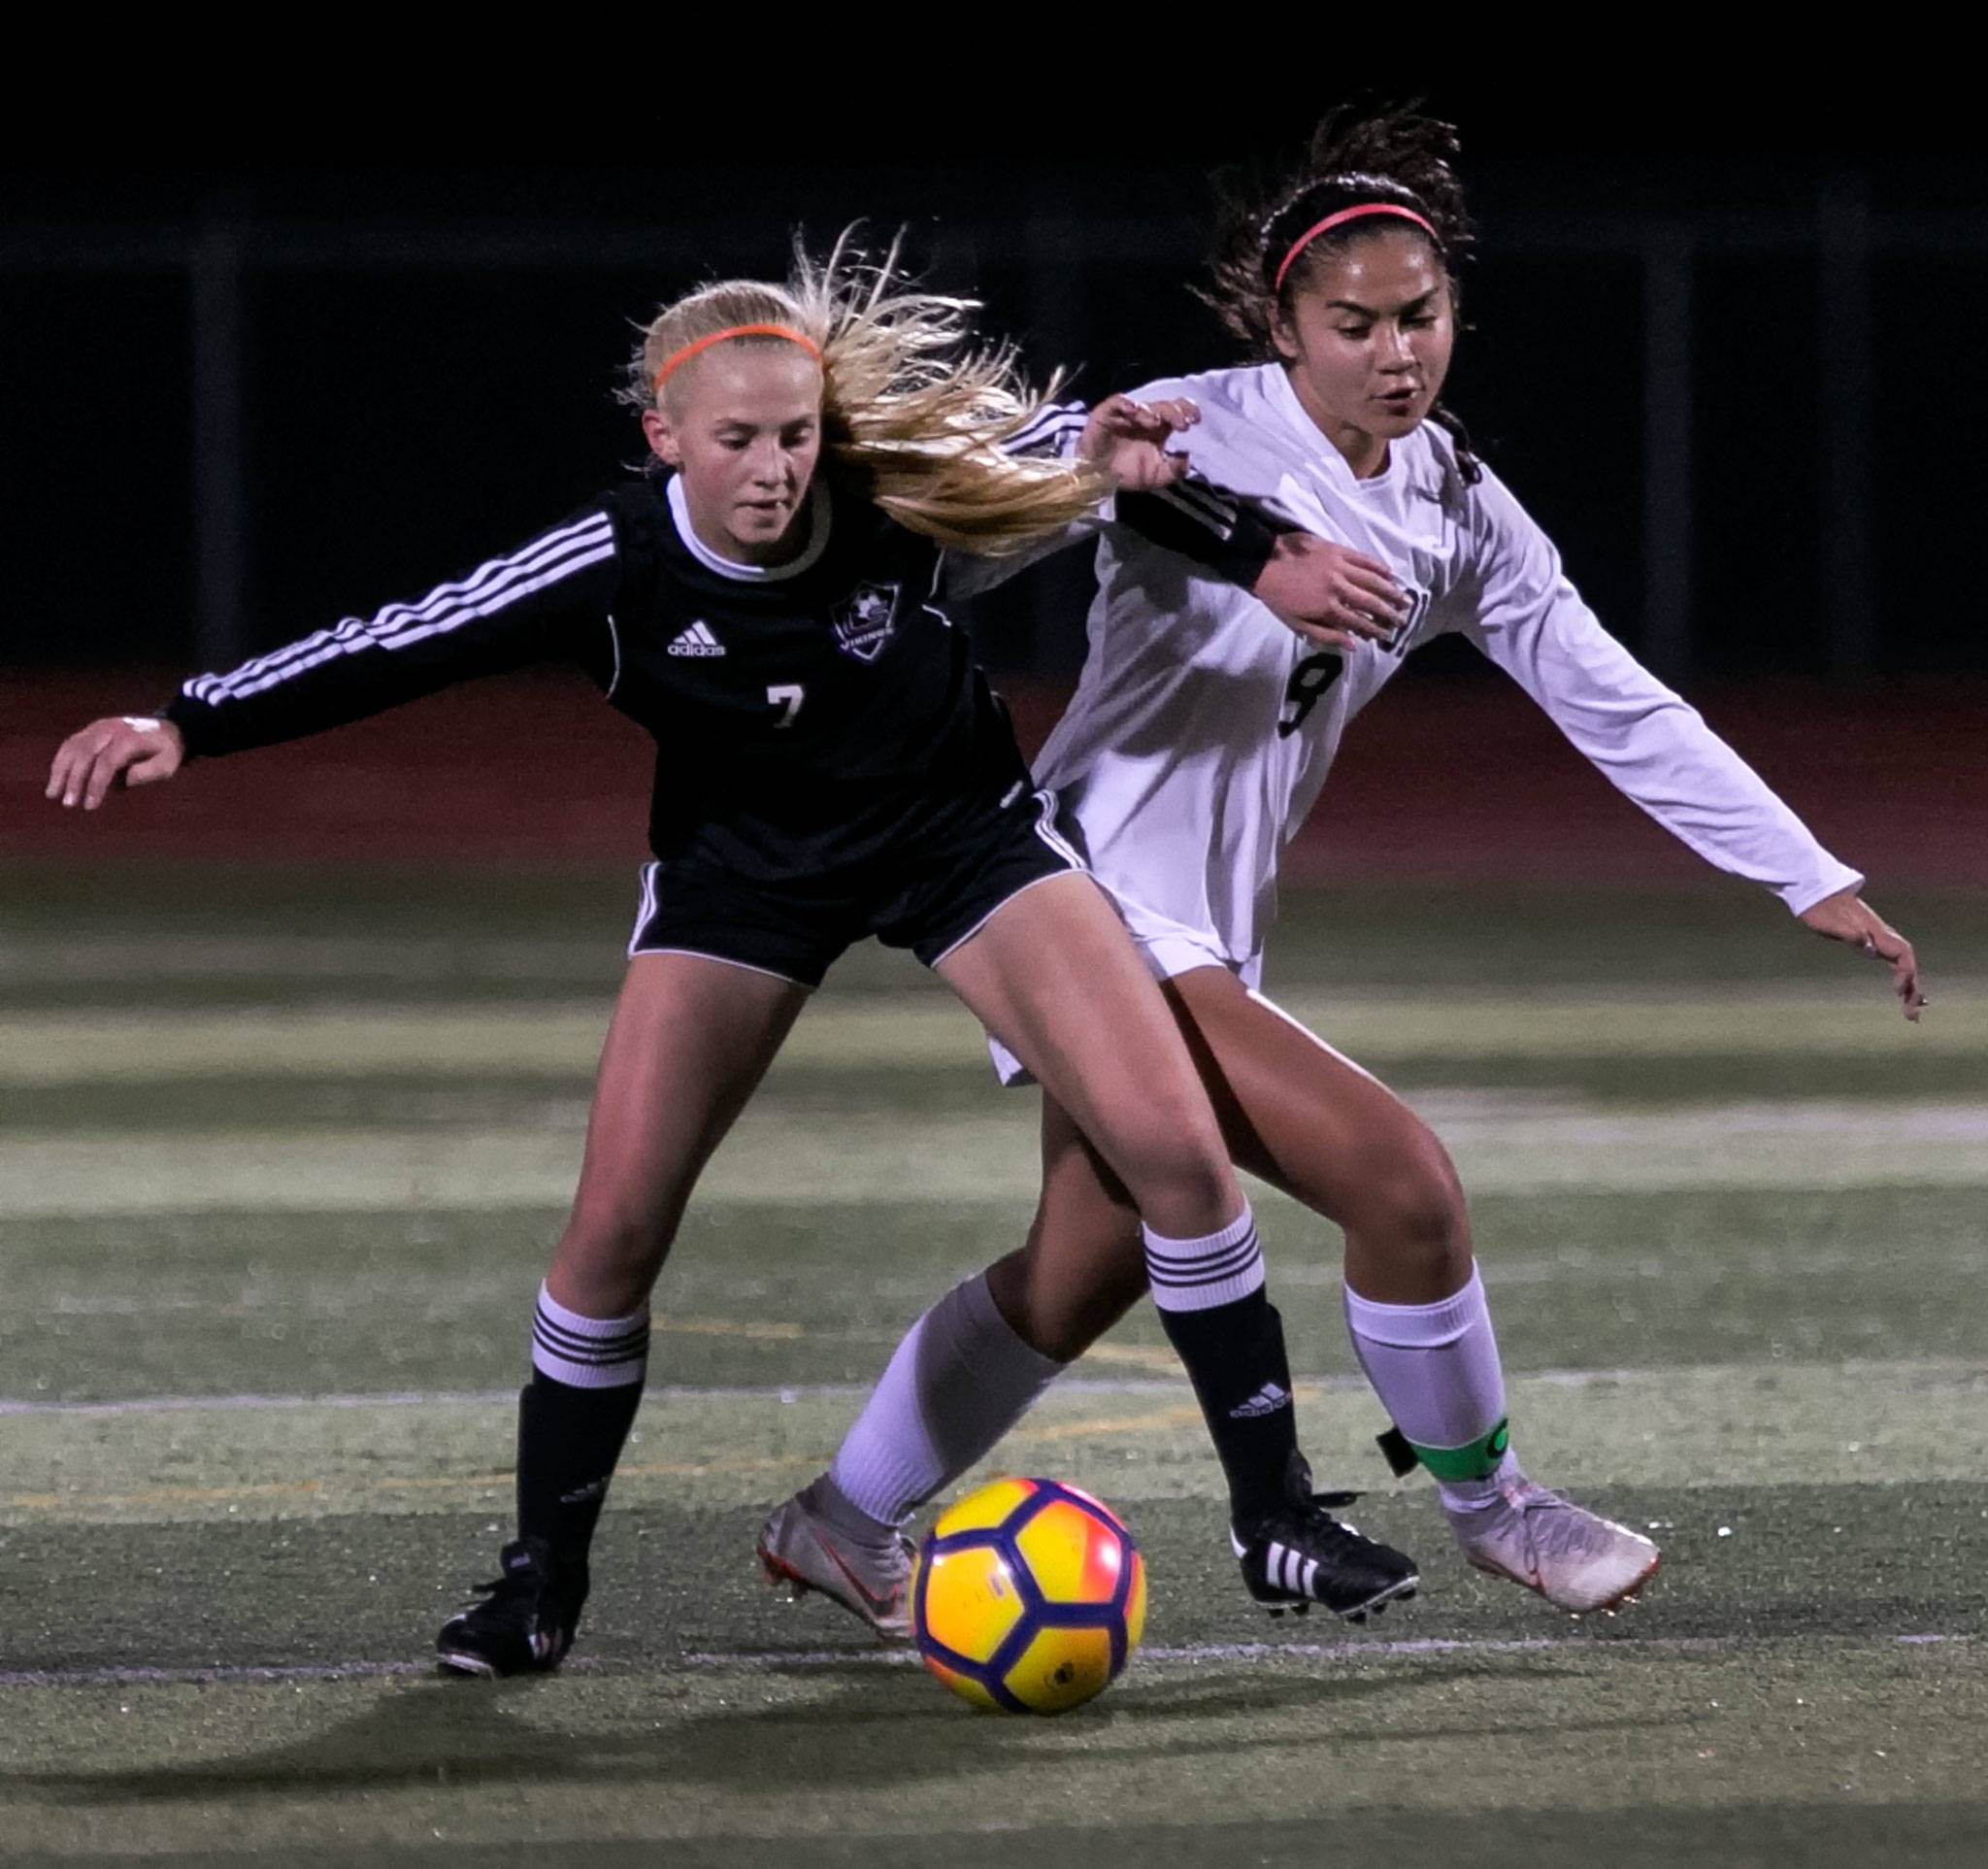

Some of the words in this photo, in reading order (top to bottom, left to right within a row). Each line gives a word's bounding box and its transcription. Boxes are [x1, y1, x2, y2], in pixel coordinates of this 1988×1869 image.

[667, 643, 726, 656] adidas
[766, 684, 804, 728] 7
[1277, 652, 1343, 739] 9
